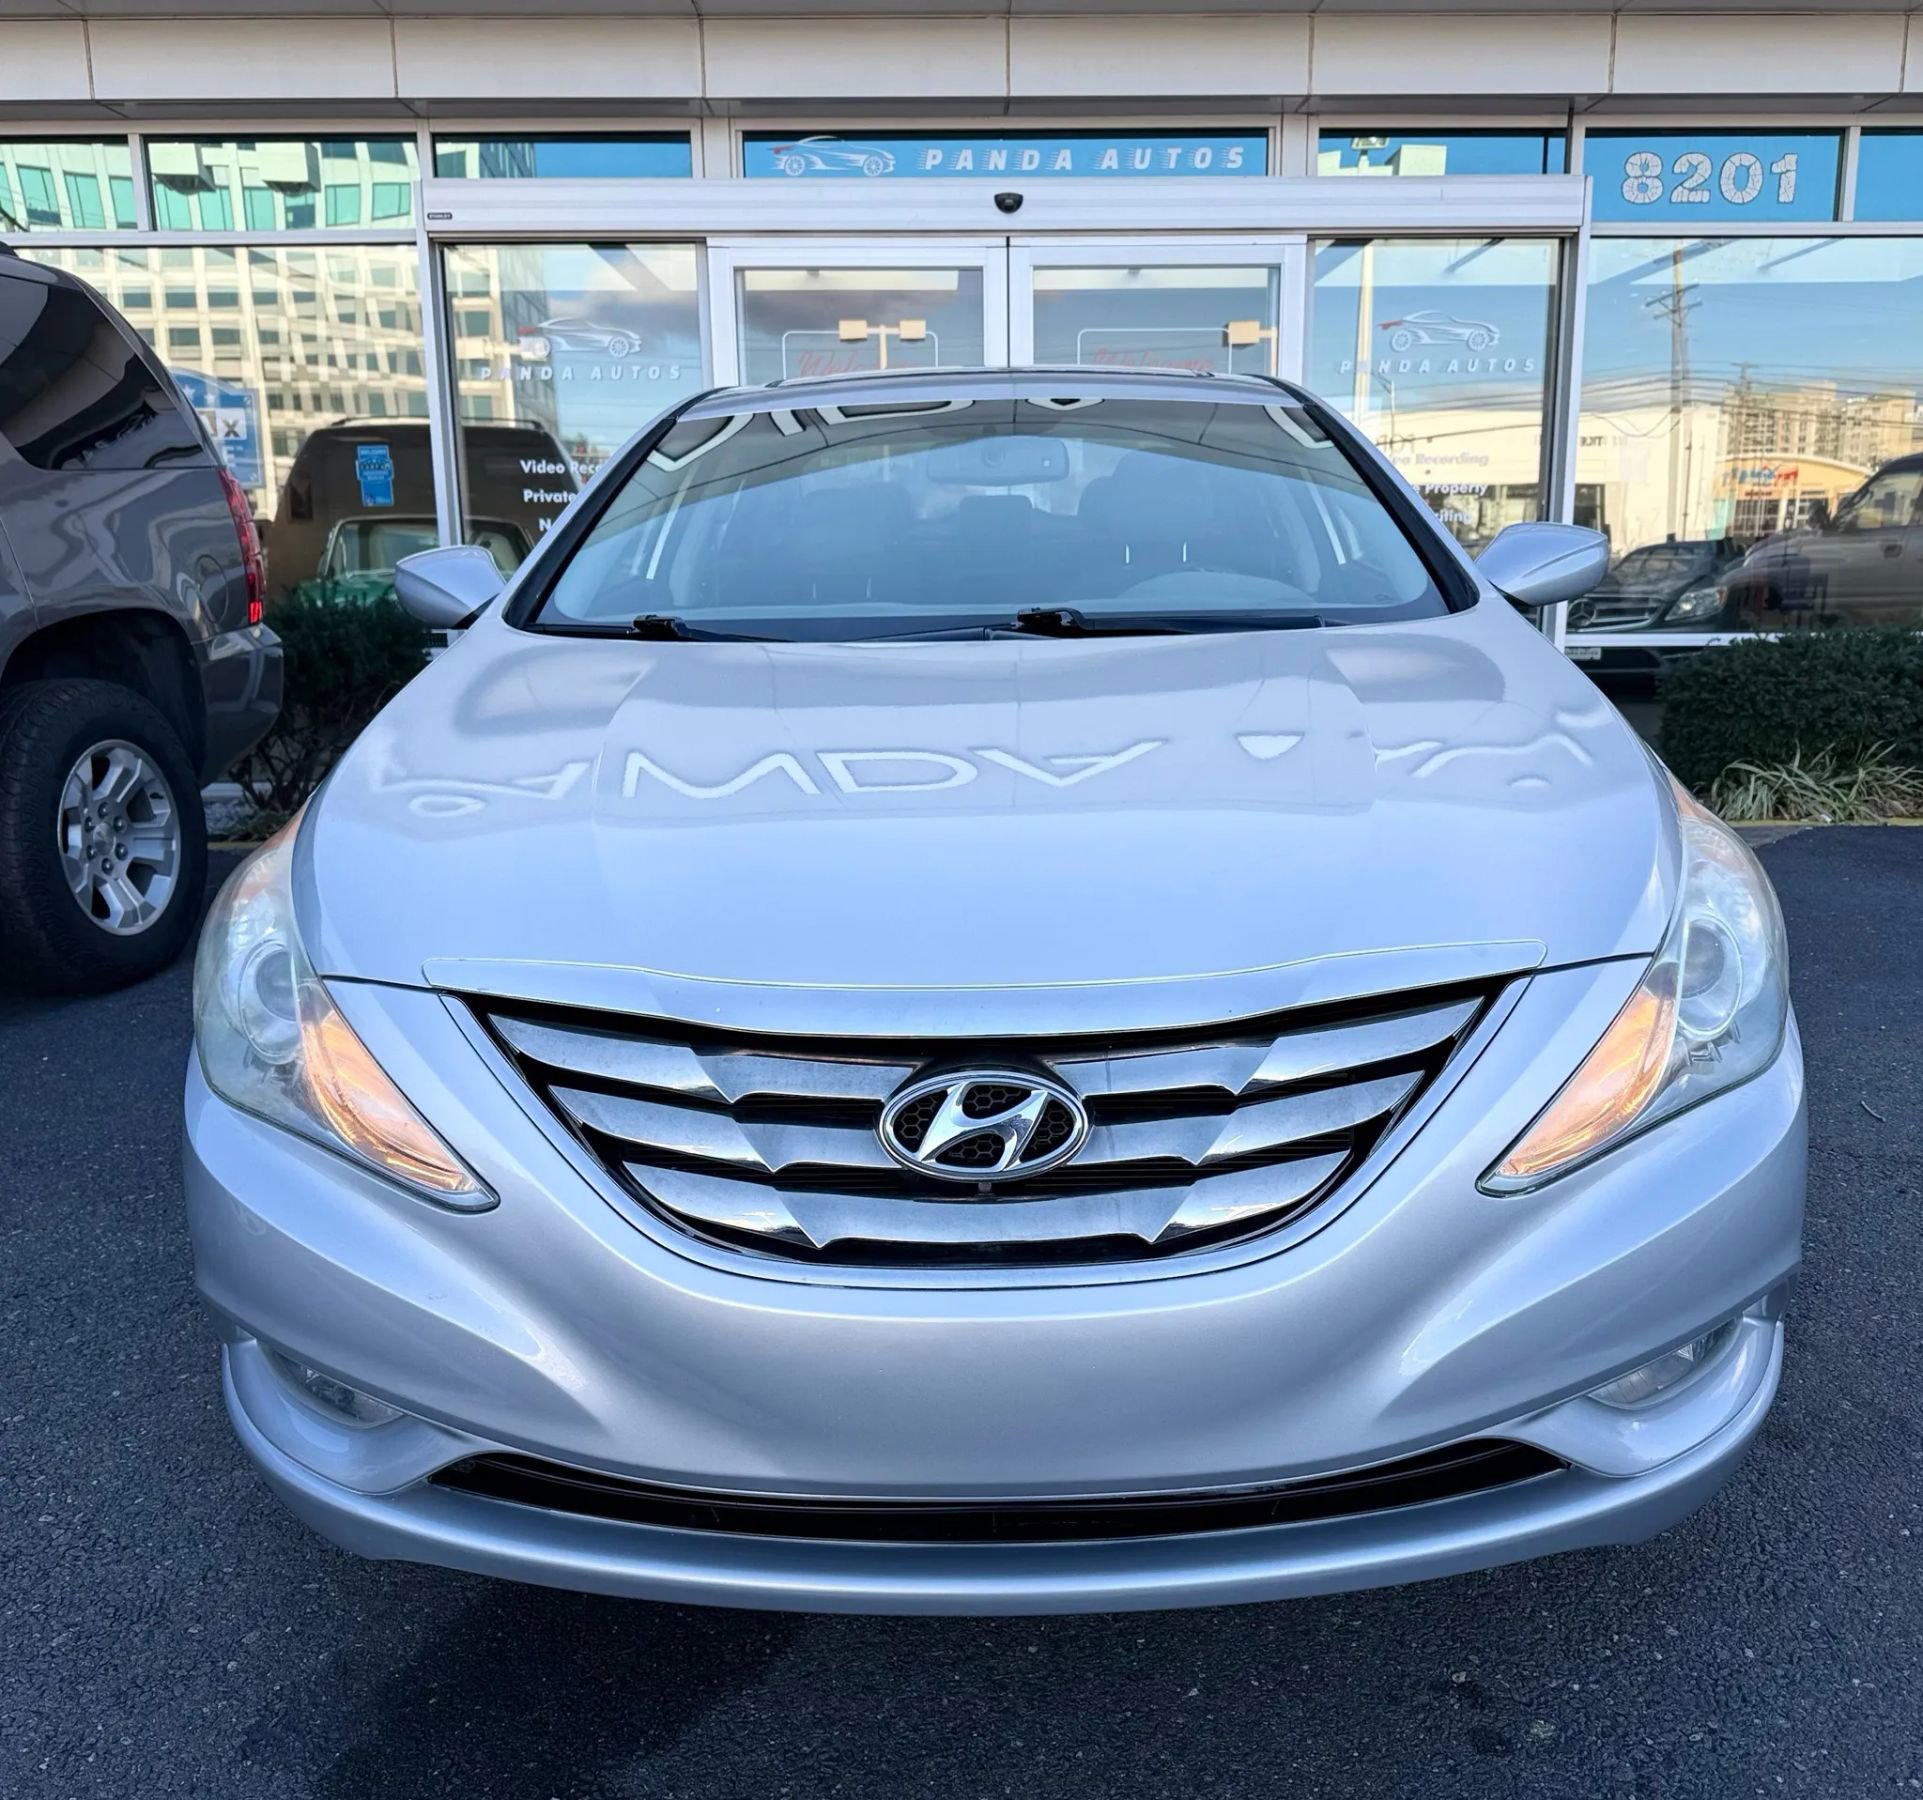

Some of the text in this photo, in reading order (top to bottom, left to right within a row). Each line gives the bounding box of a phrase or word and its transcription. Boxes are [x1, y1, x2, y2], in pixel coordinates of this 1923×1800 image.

[920, 146, 1244, 171] PANDA AUTOS
[1620, 151, 1799, 205] 8201
[480, 365, 681, 380] PANDA AUTOS
[1339, 358, 1535, 374] PANDA AUTOS
[520, 459, 566, 474] Video
[1415, 452, 1490, 467] Recording
[1425, 482, 1489, 497] Property
